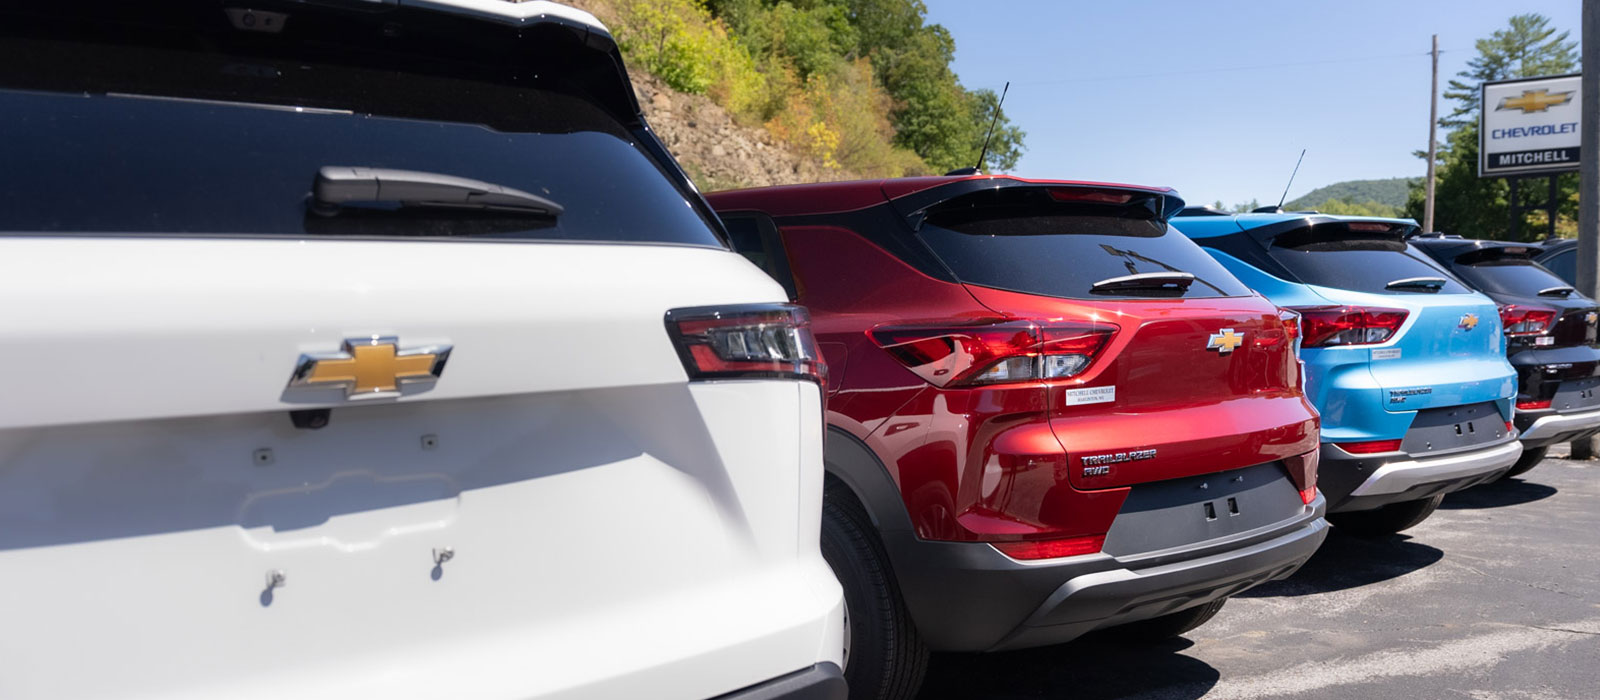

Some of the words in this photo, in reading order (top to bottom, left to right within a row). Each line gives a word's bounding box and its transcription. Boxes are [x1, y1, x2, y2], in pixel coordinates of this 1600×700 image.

[1492, 122, 1578, 140] CHEVROLET
[1499, 150, 1569, 165] MITCHELL
[1081, 449, 1157, 465] TRAILBLAZER
[1084, 465, 1110, 476] AWD
